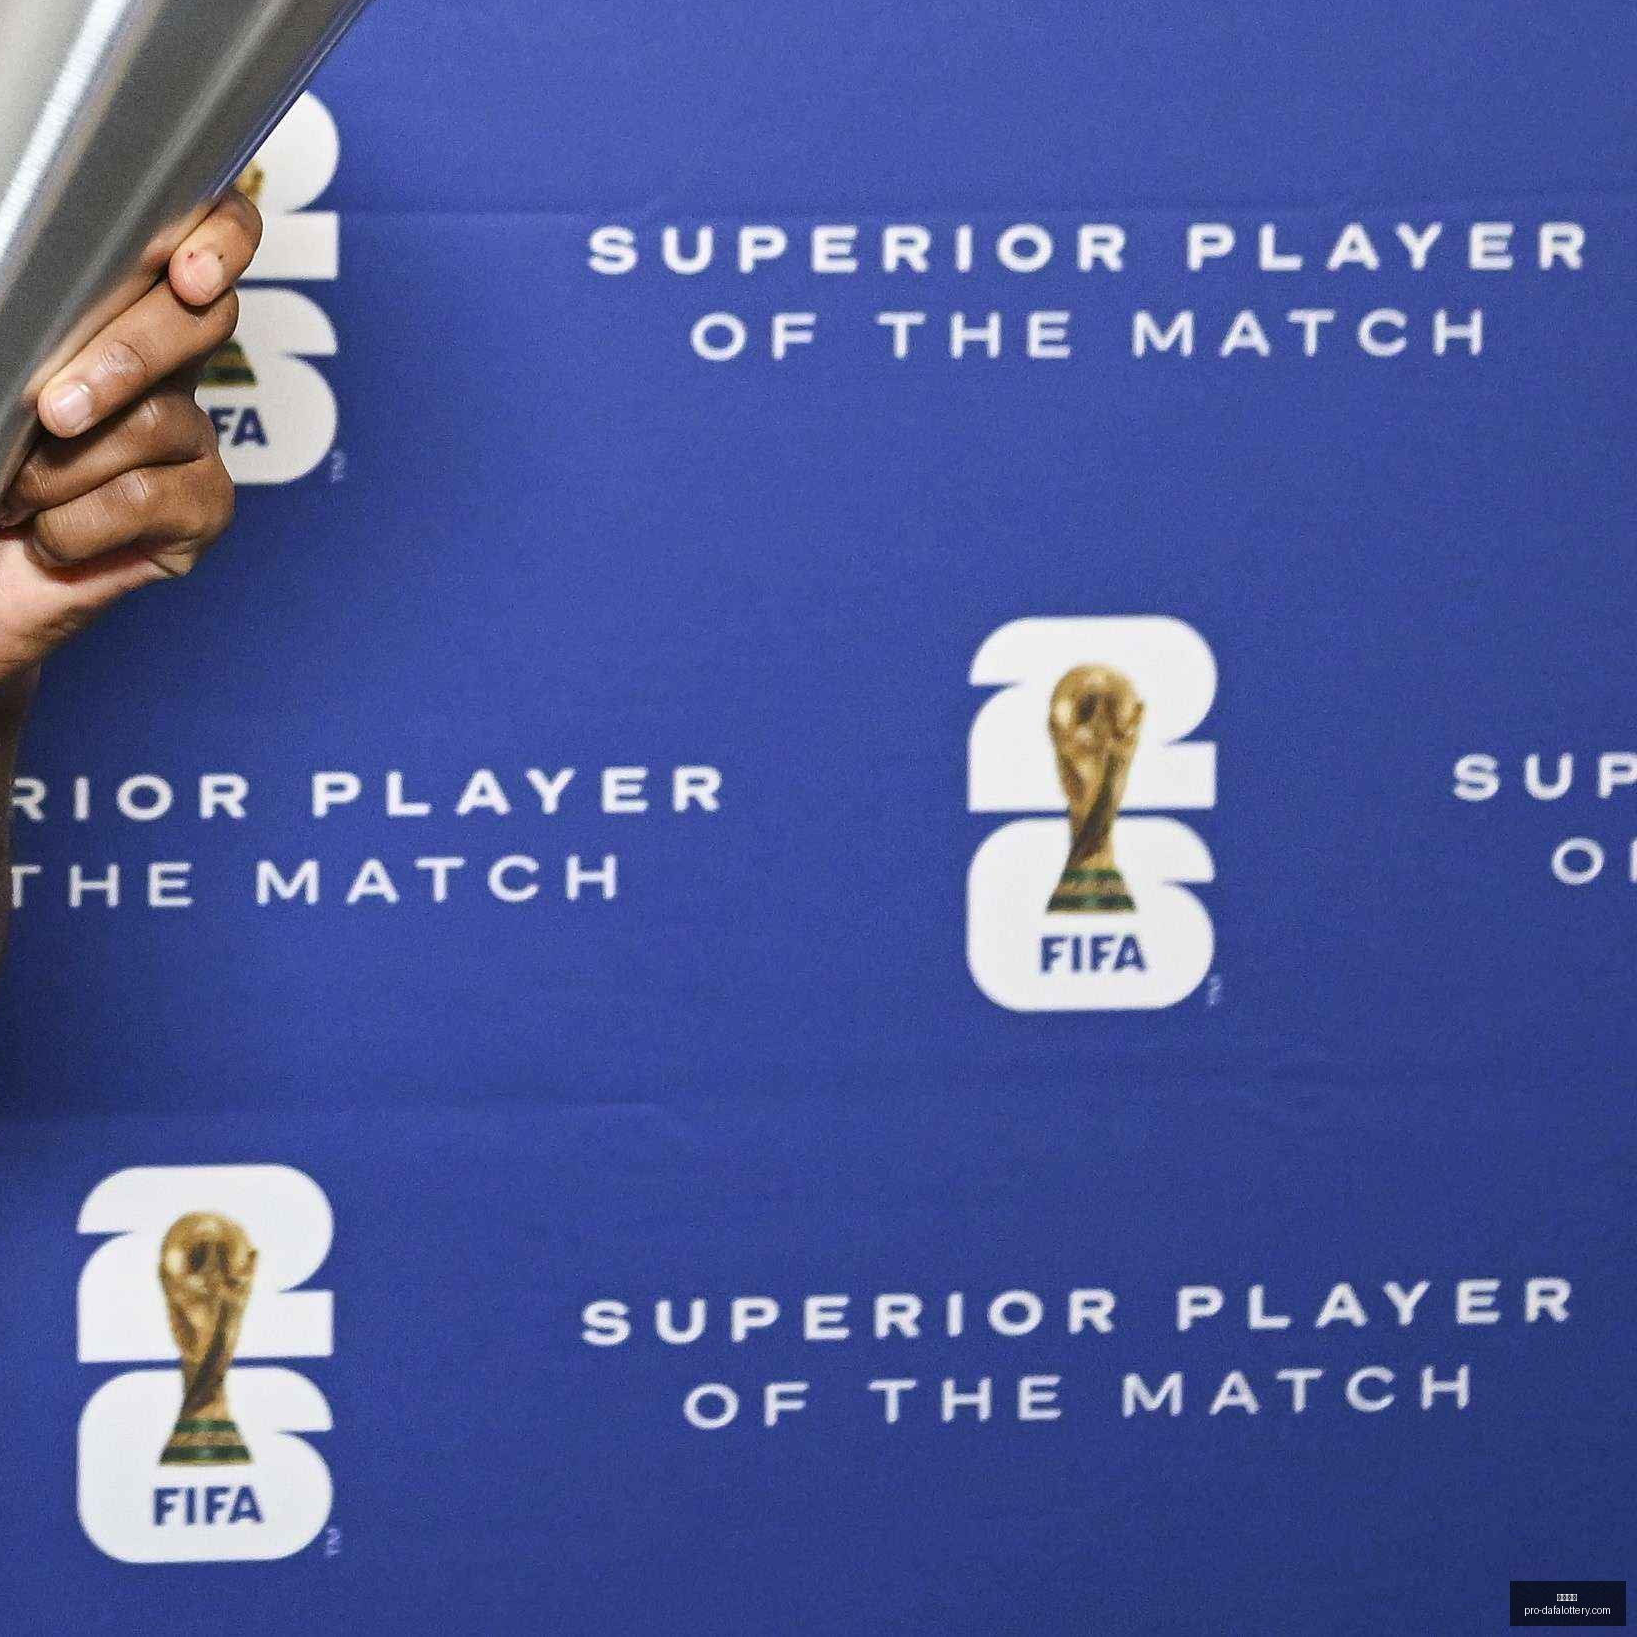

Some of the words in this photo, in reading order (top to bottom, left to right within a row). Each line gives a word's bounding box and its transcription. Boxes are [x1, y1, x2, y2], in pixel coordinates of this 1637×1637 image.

[588, 222, 1126, 276] SUPERIOR
[1186, 221, 1586, 272] PLAYER
[689, 311, 817, 362] OF
[876, 310, 1071, 360] THE
[1131, 307, 1484, 358] MATCH
[209, 405, 269, 449] FA
[11, 773, 249, 821] RIOR
[311, 765, 723, 819] PLAYER
[255, 853, 617, 907] MATCH
[1039, 933, 1147, 973] FIFA
[581, 1288, 1116, 1347] SUPERIOR
[1176, 1277, 1572, 1332] PLAYER
[683, 1381, 809, 1430] OF
[868, 1374, 1062, 1424] THE
[1122, 1364, 1470, 1418] MATCH
[152, 1485, 263, 1527] FIFA
